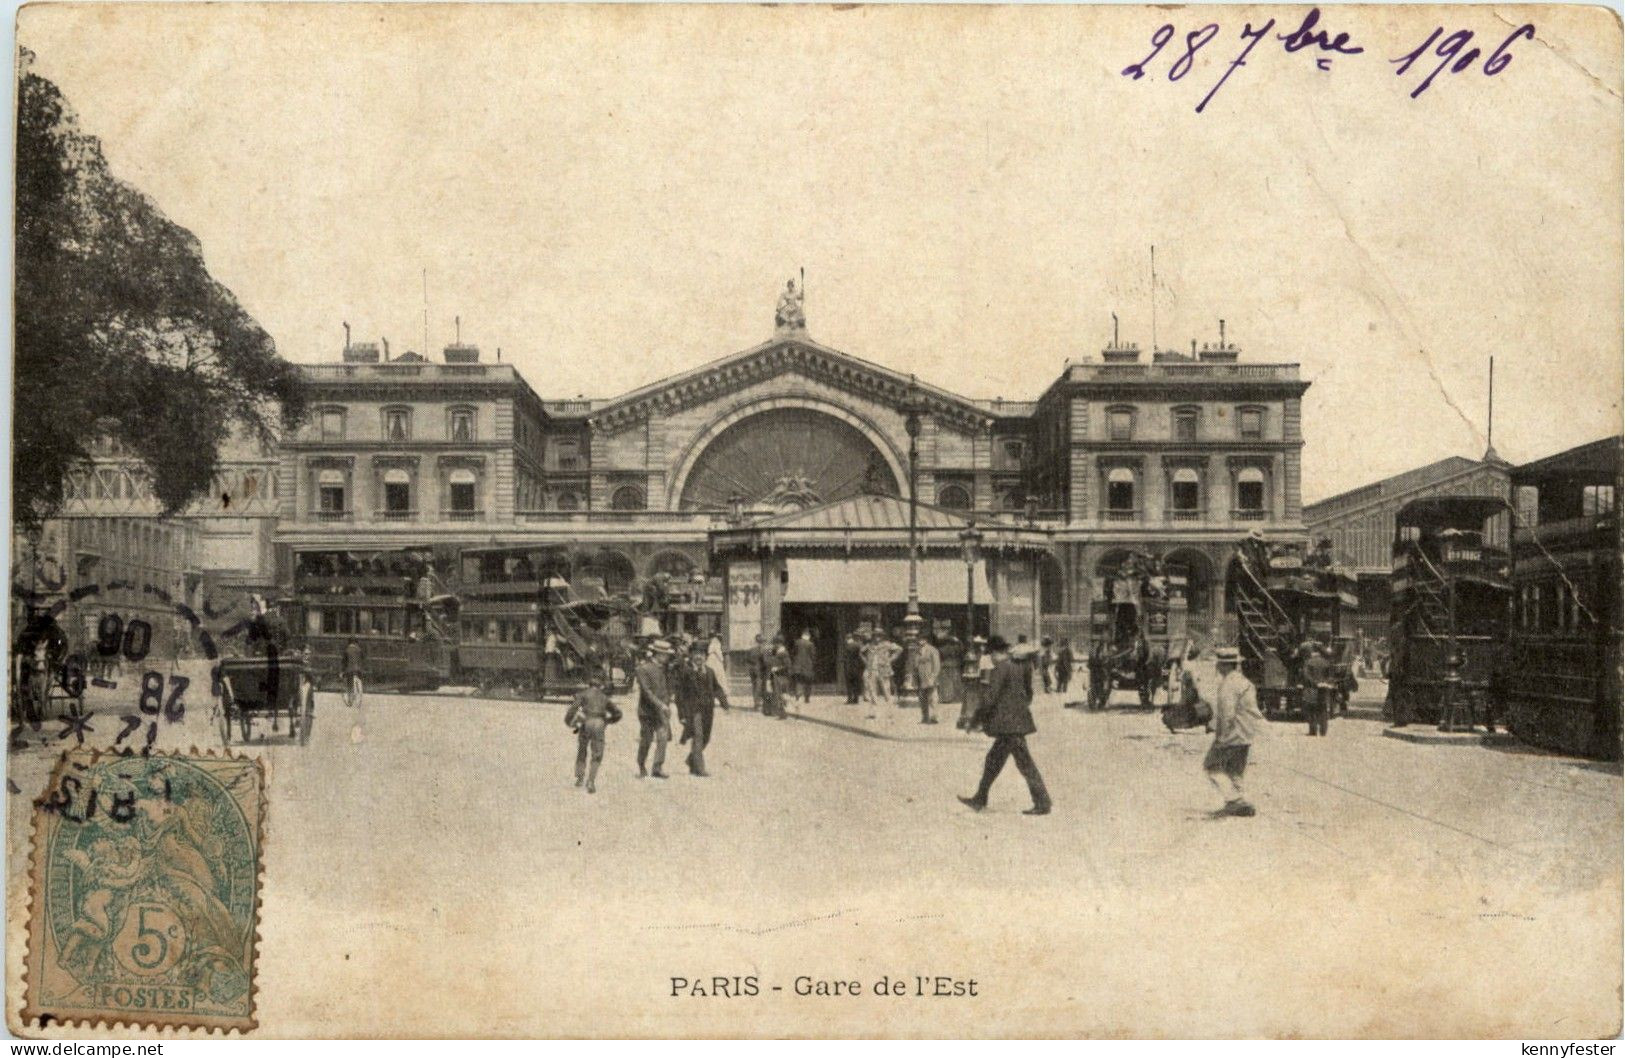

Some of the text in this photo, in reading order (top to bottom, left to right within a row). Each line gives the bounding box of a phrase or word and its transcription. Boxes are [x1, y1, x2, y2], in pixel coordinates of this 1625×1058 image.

[1122, 23, 1219, 81] 28
[1389, 24, 1535, 99] 1906
[670, 976, 760, 998] PARIS
[794, 976, 861, 997] Gare
[873, 976, 906, 997] de
[916, 976, 978, 997] l'Est
